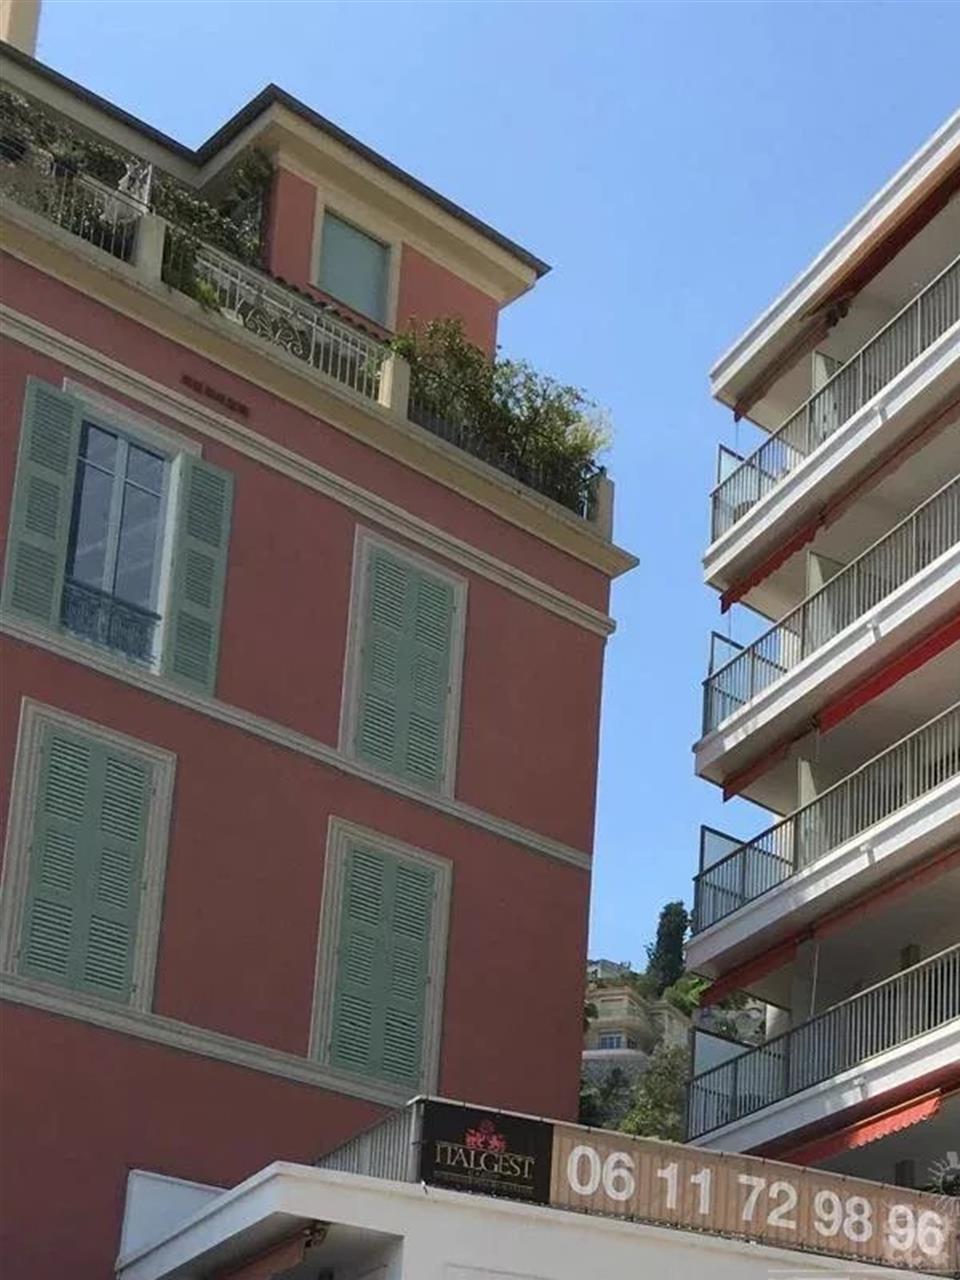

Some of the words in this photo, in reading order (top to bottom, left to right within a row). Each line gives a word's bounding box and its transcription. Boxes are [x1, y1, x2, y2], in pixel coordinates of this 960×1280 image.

[434, 1142, 535, 1178] ITALGEST
[567, 1145, 635, 1201] 06
[657, 1162, 711, 1214] 11
[738, 1174, 798, 1229] 72
[813, 1190, 873, 1242] 98
[888, 1204, 945, 1256] 96
